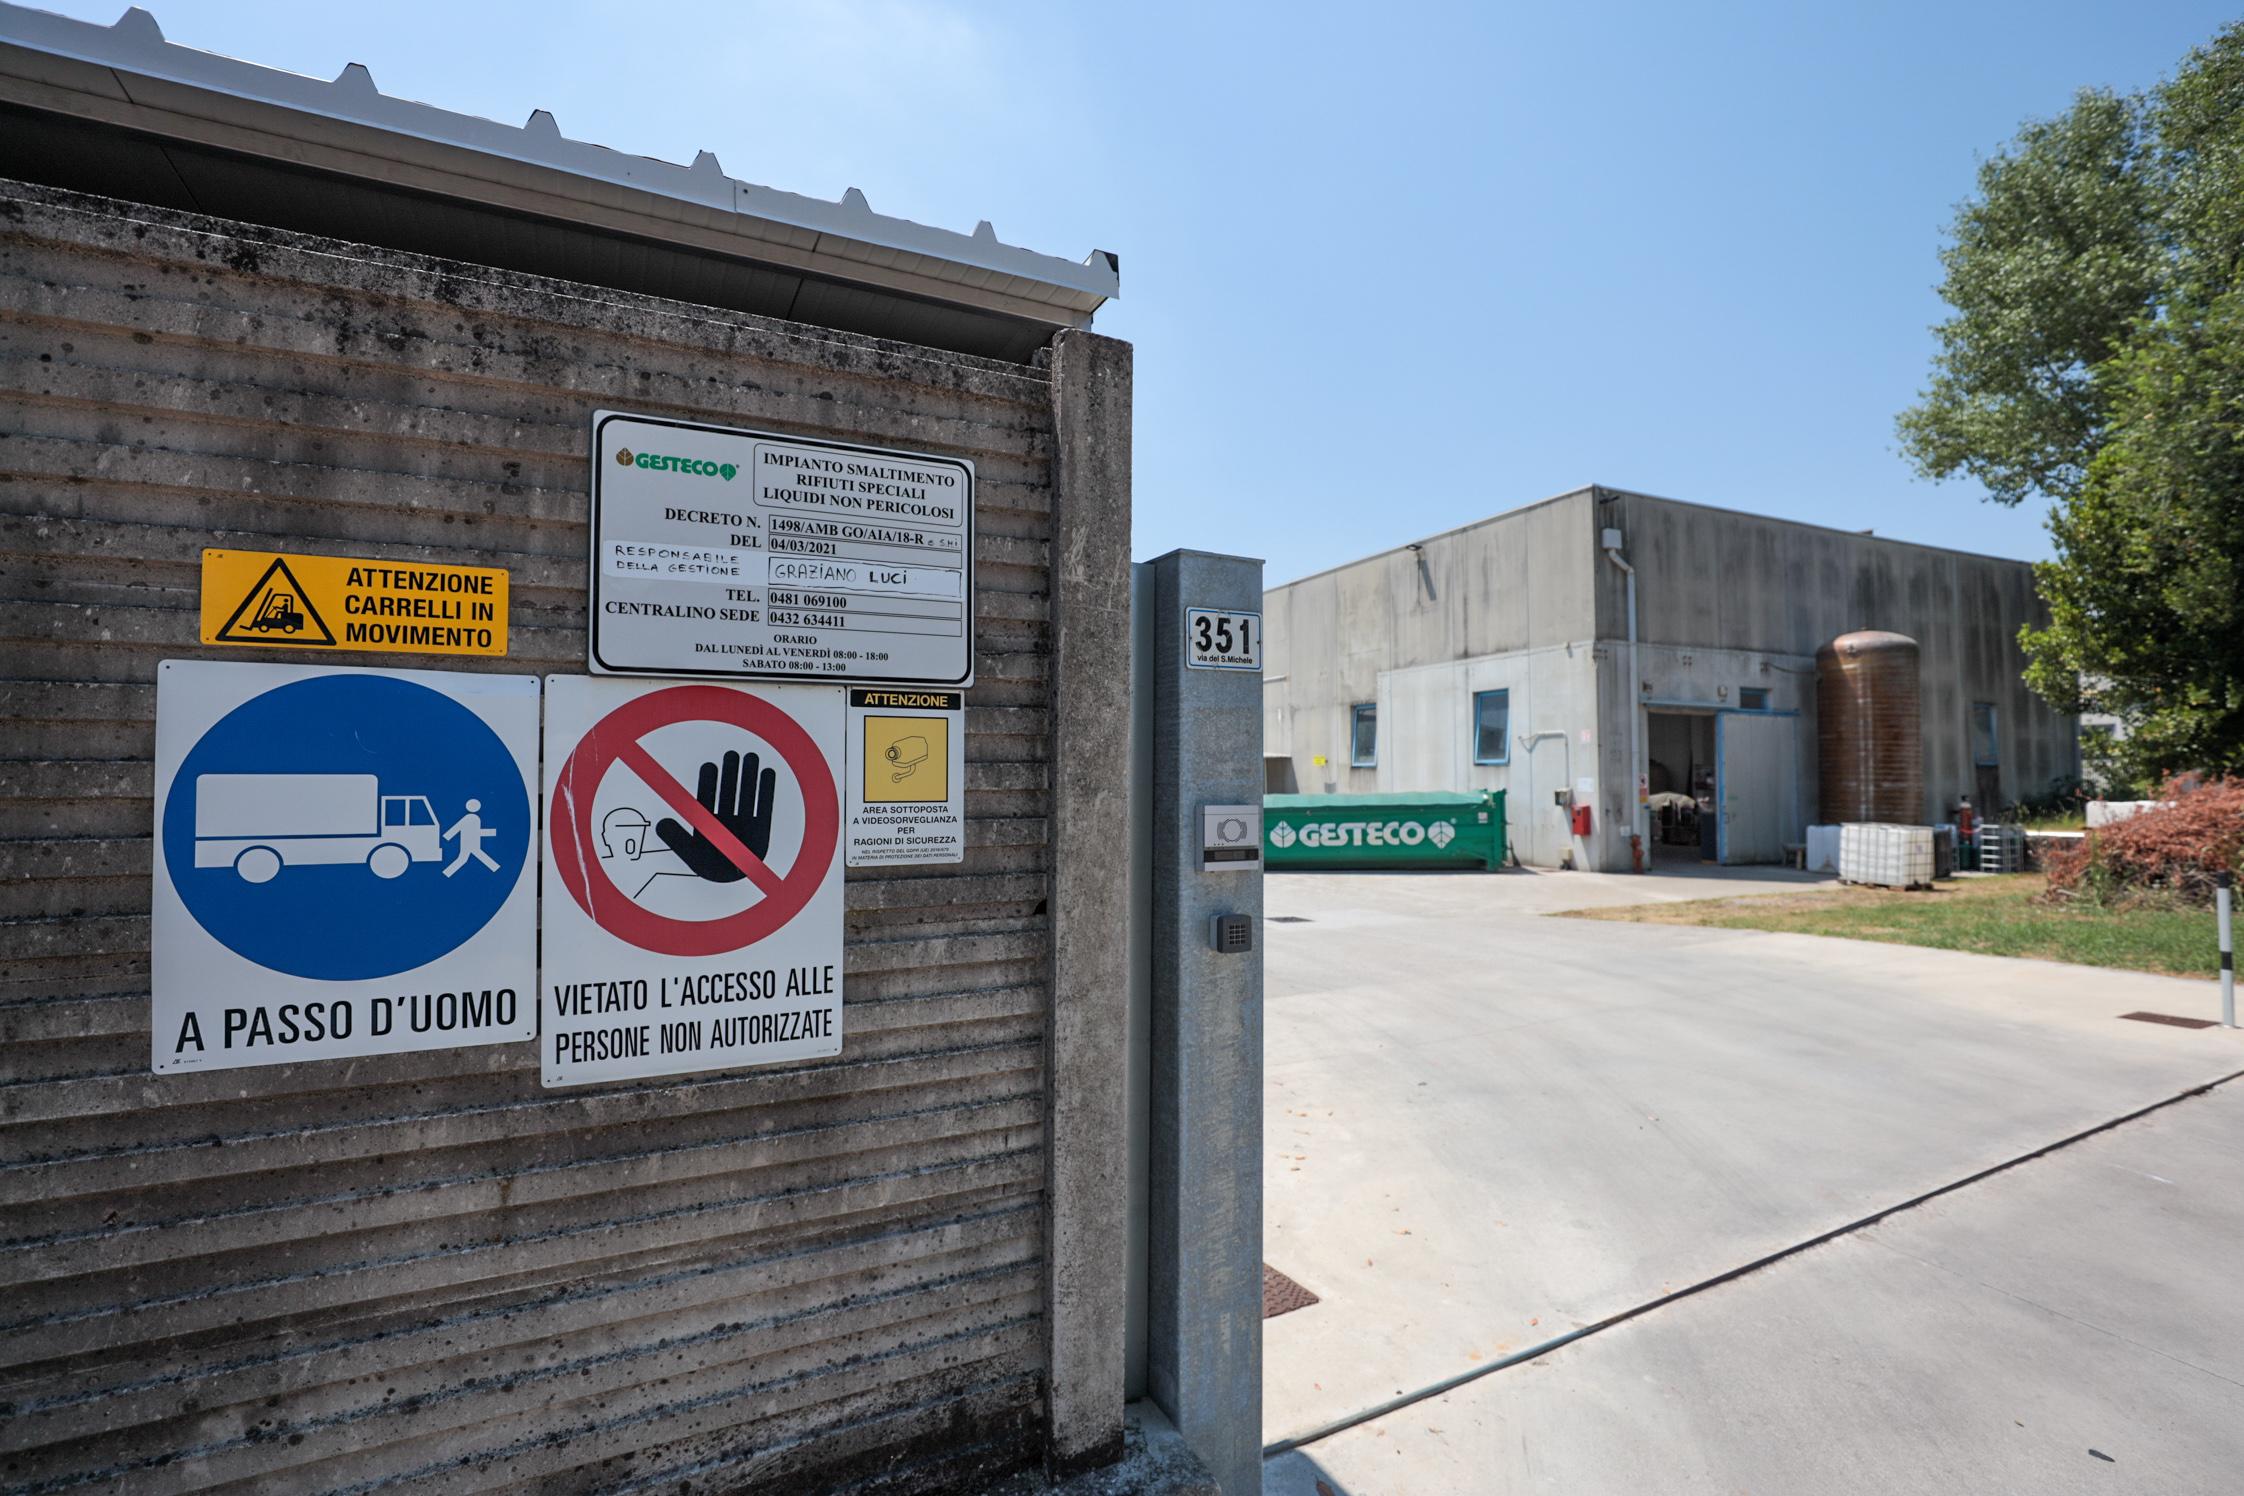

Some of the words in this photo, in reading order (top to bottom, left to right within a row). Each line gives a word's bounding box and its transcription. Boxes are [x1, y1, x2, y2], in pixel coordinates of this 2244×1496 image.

[635, 452, 718, 477] GESTECO
[764, 452, 843, 473] IMPIANTO
[847, 464, 955, 488] SMALTIMENTO
[796, 474, 854, 492] RIFIUTI
[858, 481, 926, 500] SPECIALI
[763, 487, 825, 505] LIQUIDI
[830, 494, 862, 508] NON
[866, 498, 954, 519] PERICOLOSI
[664, 508, 742, 526] DECRETO
[746, 516, 761, 528] N.
[770, 518, 838, 536] 1498/AMB
[842, 525, 924, 545] GO/AIA/18-R
[615, 545, 740, 564] RESPONSABILE
[730, 534, 762, 548] DEL
[770, 538, 836, 555] 04/03/2021
[616, 560, 658, 572] DELLA
[346, 567, 494, 595] ATTENZIONE
[344, 594, 461, 620] CARRELLI
[471, 602, 494, 621] IN
[726, 588, 760, 602] TEL.
[770, 592, 799, 604] 0481
[804, 594, 847, 608] 069100
[605, 600, 716, 620] CENTRALINO
[720, 608, 760, 622] SEDE
[770, 612, 799, 624] 0432
[803, 615, 846, 628] 634411
[346, 622, 492, 648] MOVIMENTO
[773, 634, 818, 645] ORARIO
[1194, 616, 1250, 654] 351
[695, 643, 719, 654] DAL
[721, 644, 764, 656] LUNEDÌ
[766, 646, 781, 656] AL
[783, 648, 831, 658] VENERDÌ
[833, 651, 858, 660] 08:00
[866, 652, 889, 661] 18:00
[742, 658, 786, 670] SABATO
[788, 661, 814, 670] 08:00
[822, 662, 846, 672] 13:00
[864, 692, 948, 708] ATTENZIONE
[862, 816, 958, 825] VIDEOSORVEGLIANZA
[890, 806, 948, 814] SOTTOPOSTA
[854, 838, 892, 846] RAGIONI
[894, 837, 904, 845] DI
[906, 836, 956, 845] SICUREZZA
[1298, 820, 1426, 848] GESTECO
[554, 979, 648, 1017] VIETATO
[661, 970, 776, 1008] L'ACCESSO
[785, 965, 834, 998] ALLE
[175, 1011, 205, 1054] A
[223, 1000, 353, 1050] PASSO
[371, 988, 516, 1037] D'UOMO
[555, 1025, 650, 1065] PERSONE
[660, 1020, 702, 1054] NON
[710, 1008, 832, 1050] AUTORIZZATE
